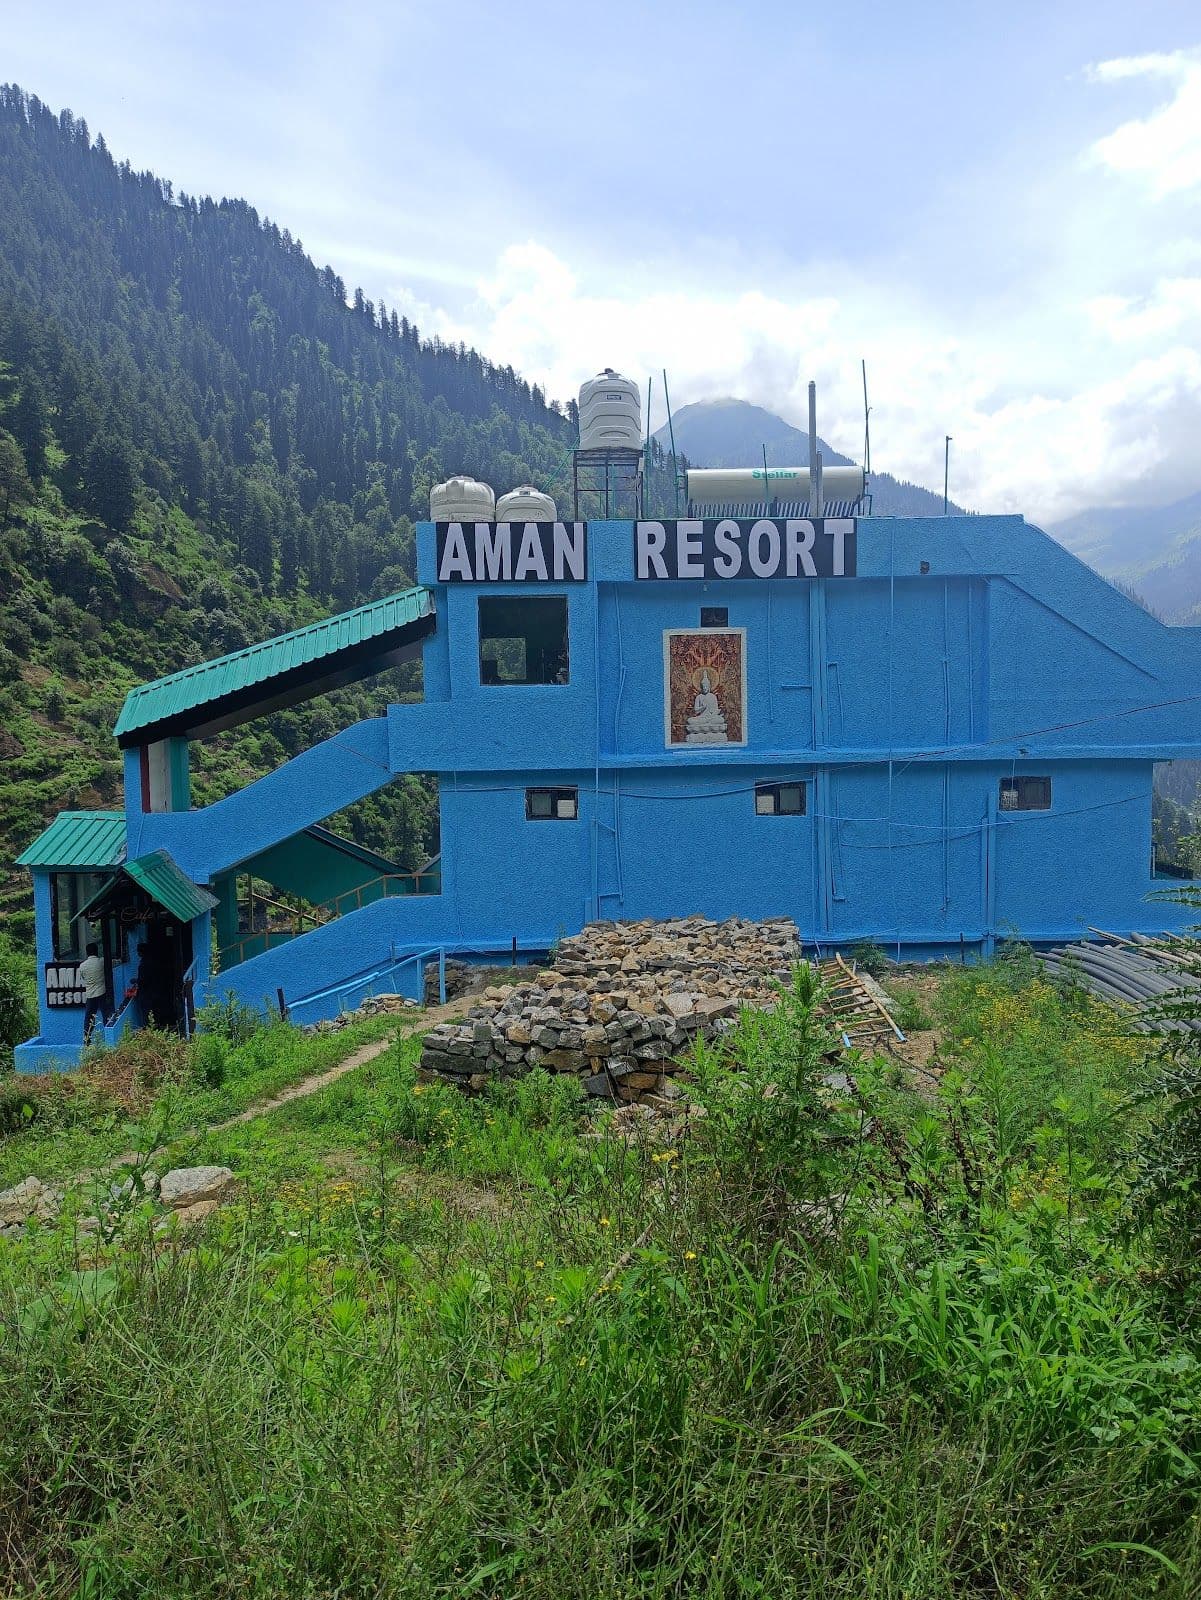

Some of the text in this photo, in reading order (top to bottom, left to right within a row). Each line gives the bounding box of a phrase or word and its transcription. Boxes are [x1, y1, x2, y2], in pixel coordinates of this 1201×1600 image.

[752, 470, 798, 479] Stellar
[438, 519, 855, 581] AMAN RESORT
[46, 967, 87, 988] AMA
[48, 991, 88, 1005] RESO
